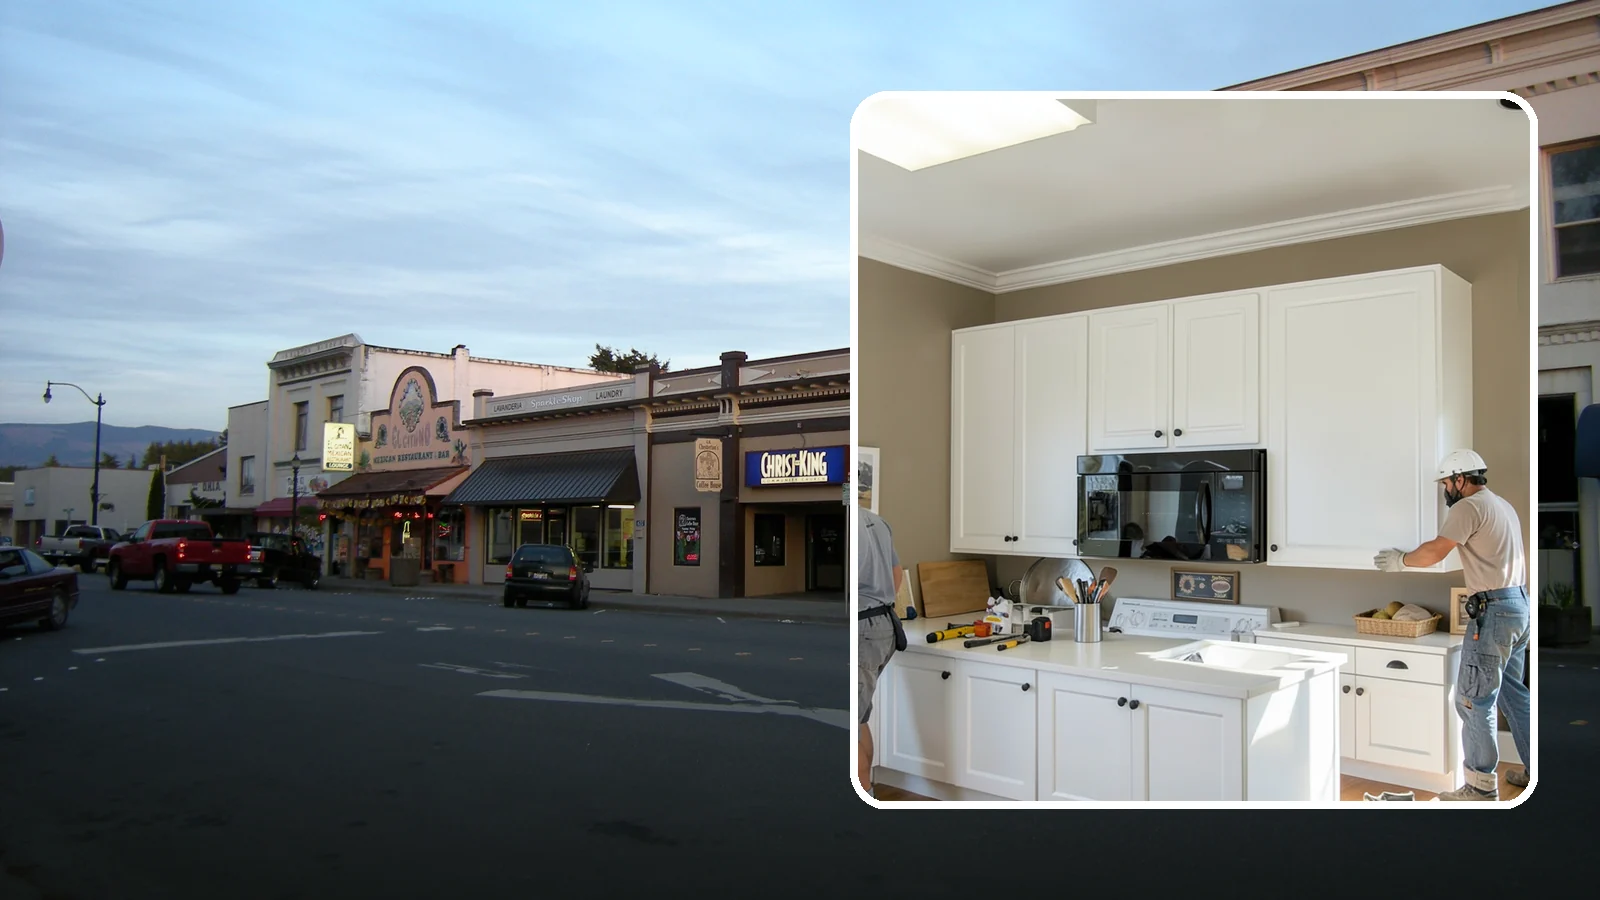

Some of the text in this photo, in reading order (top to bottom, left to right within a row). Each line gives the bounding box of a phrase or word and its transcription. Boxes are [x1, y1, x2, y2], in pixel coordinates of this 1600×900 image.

[562, 394, 583, 406] Shop
[595, 388, 624, 400] LAUNDRY
[493, 402, 522, 413] LAVANDERIA
[373, 454, 396, 464] MEXICAN
[397, 451, 434, 462] RESTAURANT
[437, 450, 450, 459] BAR
[696, 480, 709, 489] Coffee
